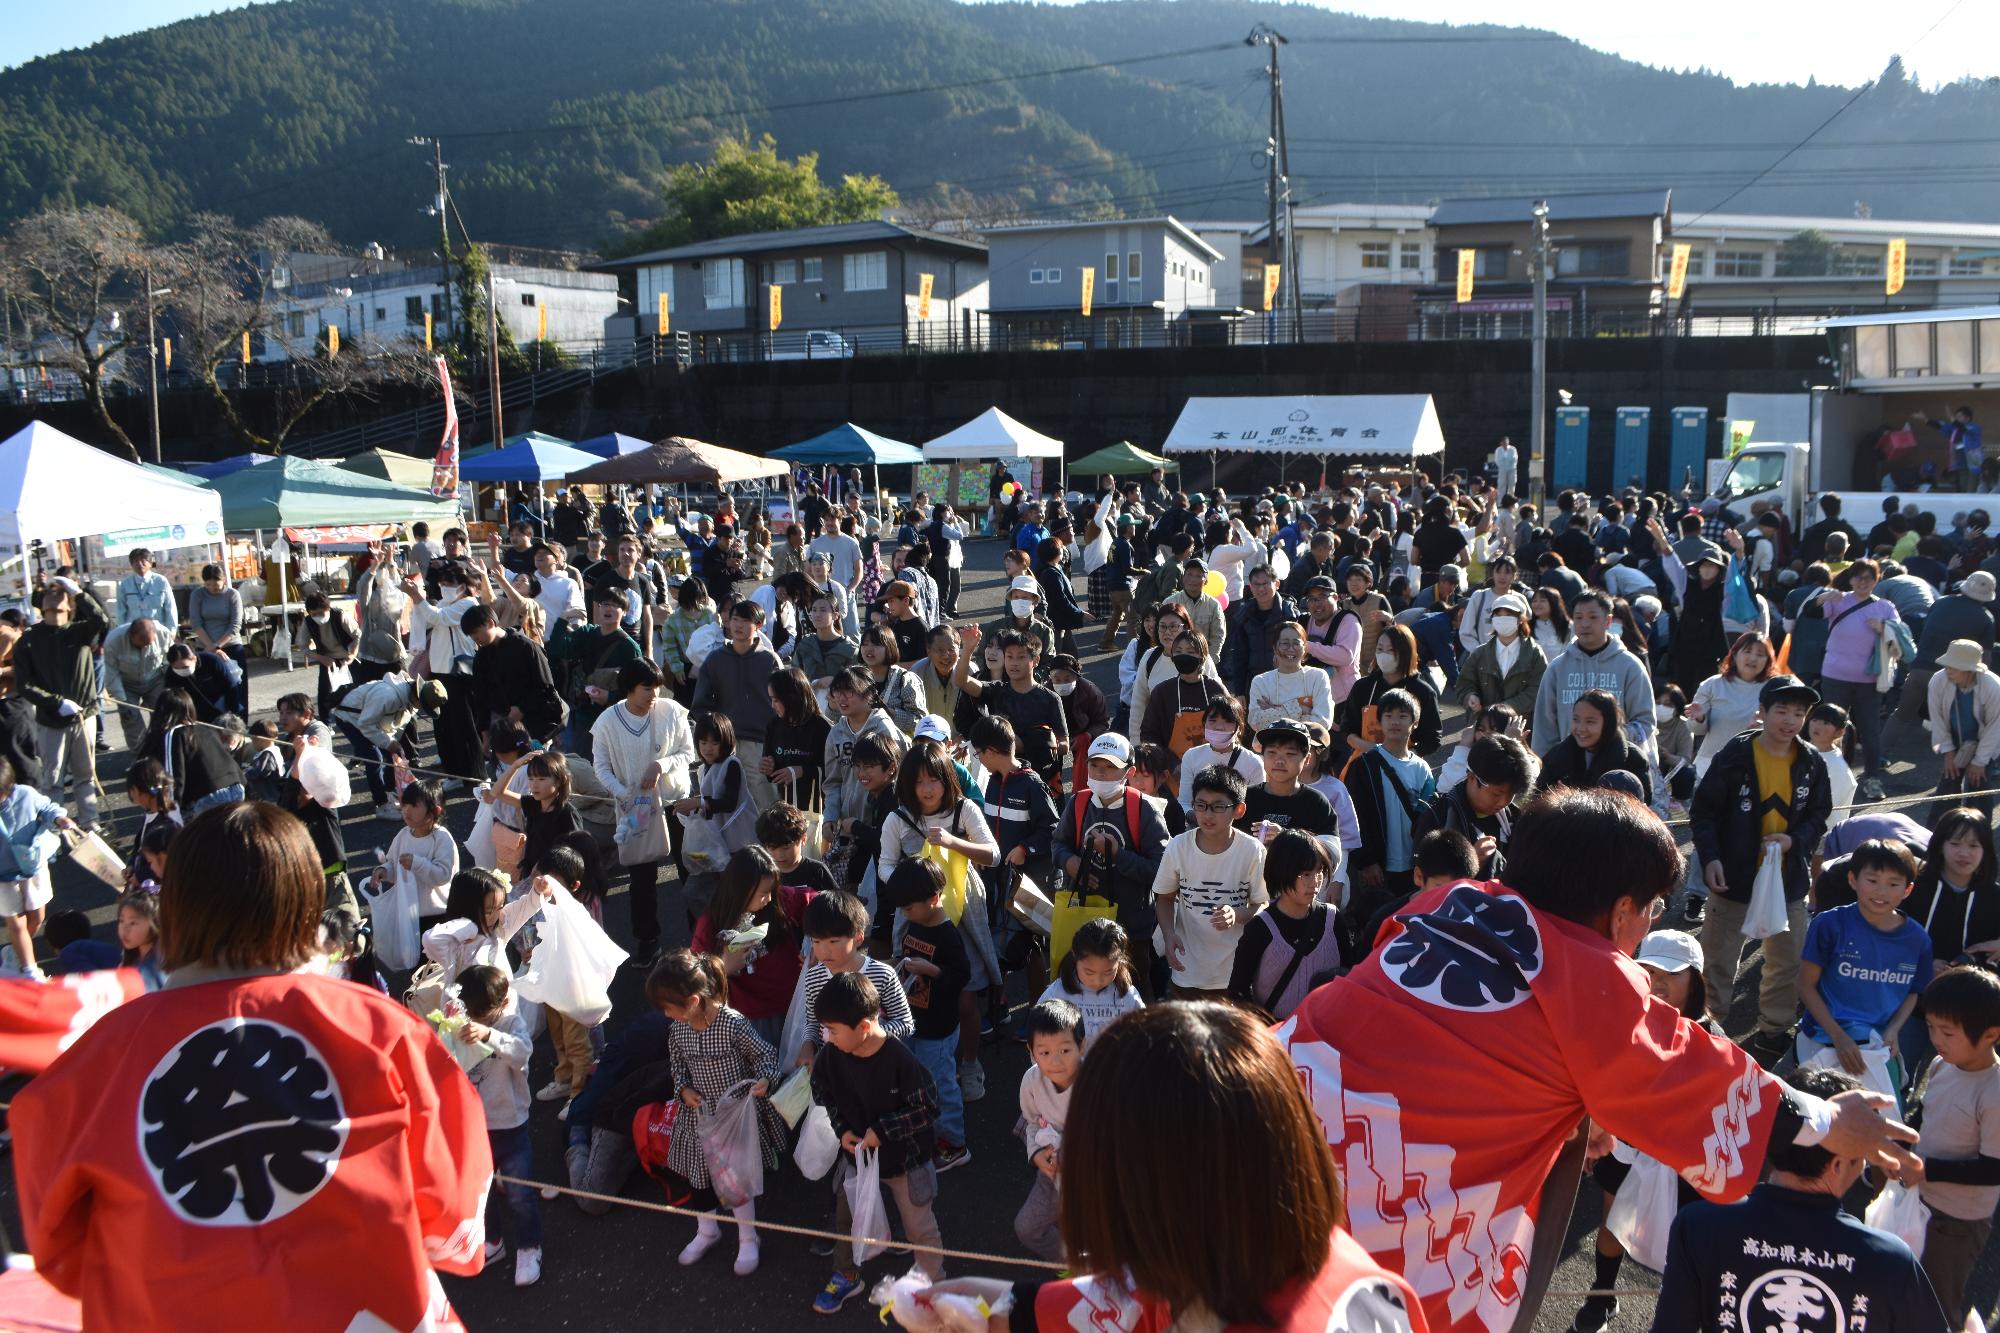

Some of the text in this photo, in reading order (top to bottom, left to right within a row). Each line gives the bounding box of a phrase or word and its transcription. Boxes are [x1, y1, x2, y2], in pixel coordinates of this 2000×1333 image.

[1567, 672, 1617, 688] COLUMBIA
[1838, 961, 1915, 985] Grandeur
[143, 1022, 343, 1222] 祭
[1742, 1237, 1856, 1272] 高知県本山町
[1718, 1271, 1738, 1333] 家内安
